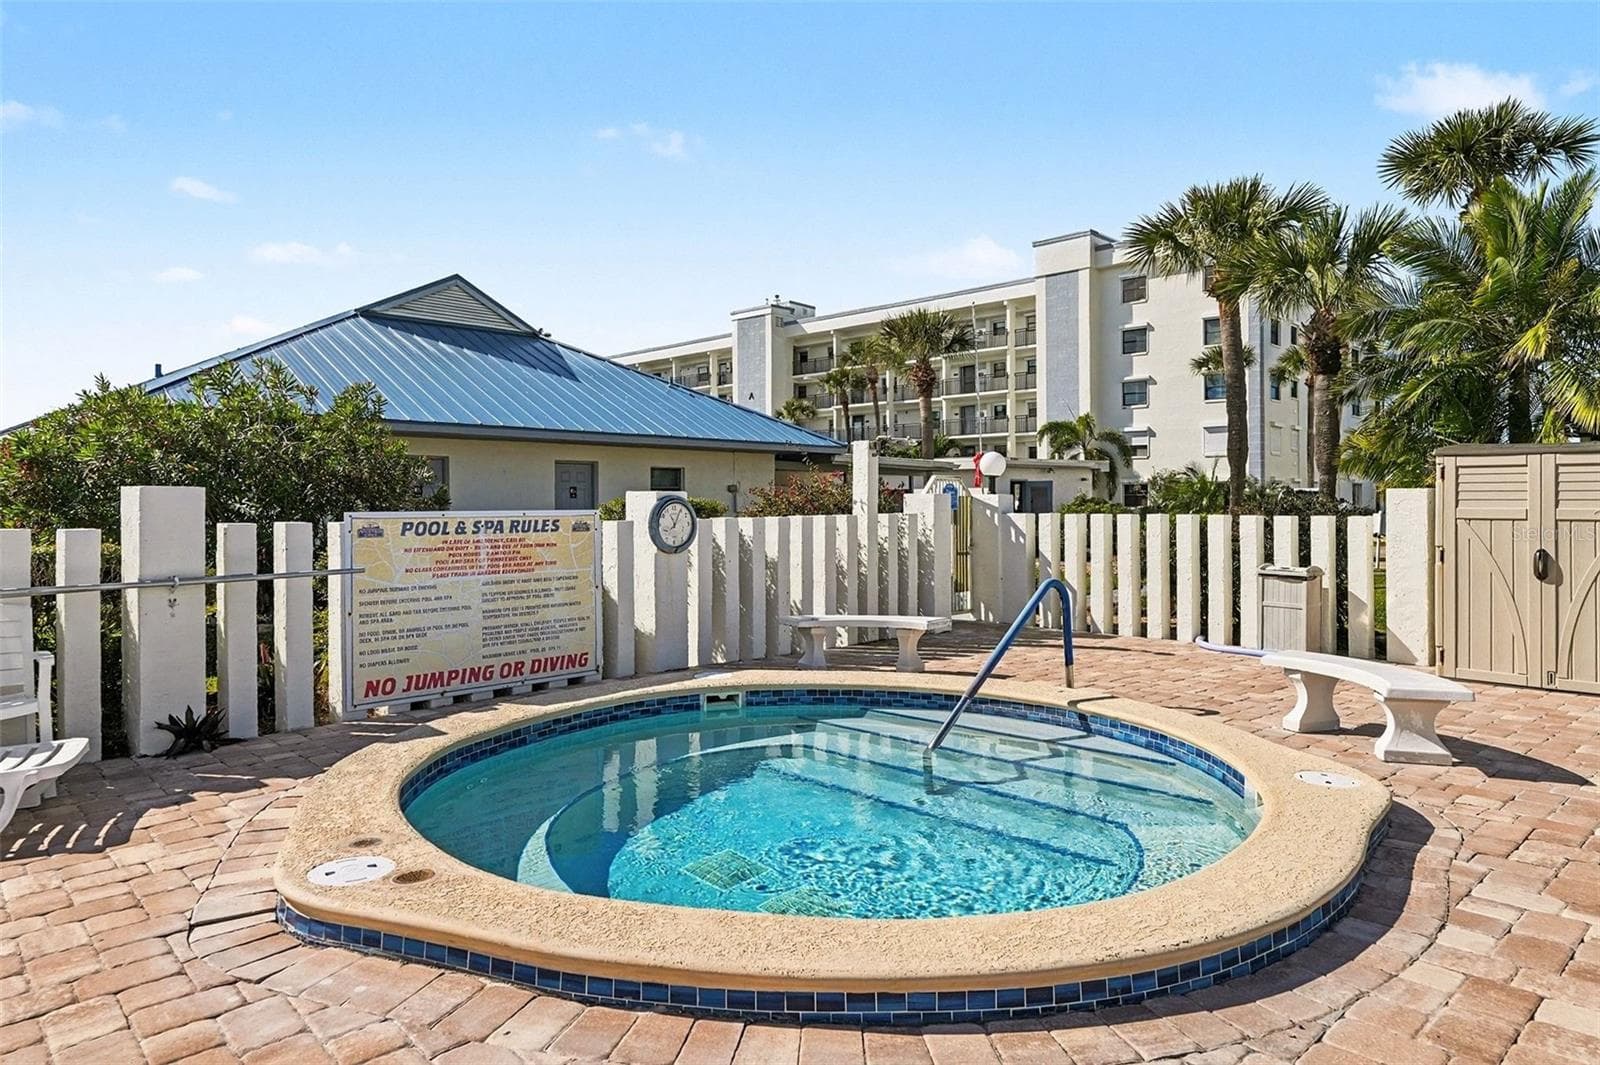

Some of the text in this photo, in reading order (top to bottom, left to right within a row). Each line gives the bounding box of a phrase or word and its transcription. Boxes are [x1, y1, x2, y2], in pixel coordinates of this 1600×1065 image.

[748, 392, 754, 400] A
[400, 521, 450, 536] POOL
[455, 521, 467, 535] &
[472, 520, 504, 534] SPA
[509, 519, 560, 533] RULES
[364, 652, 589, 698] NO JUMPING OR DIVING
